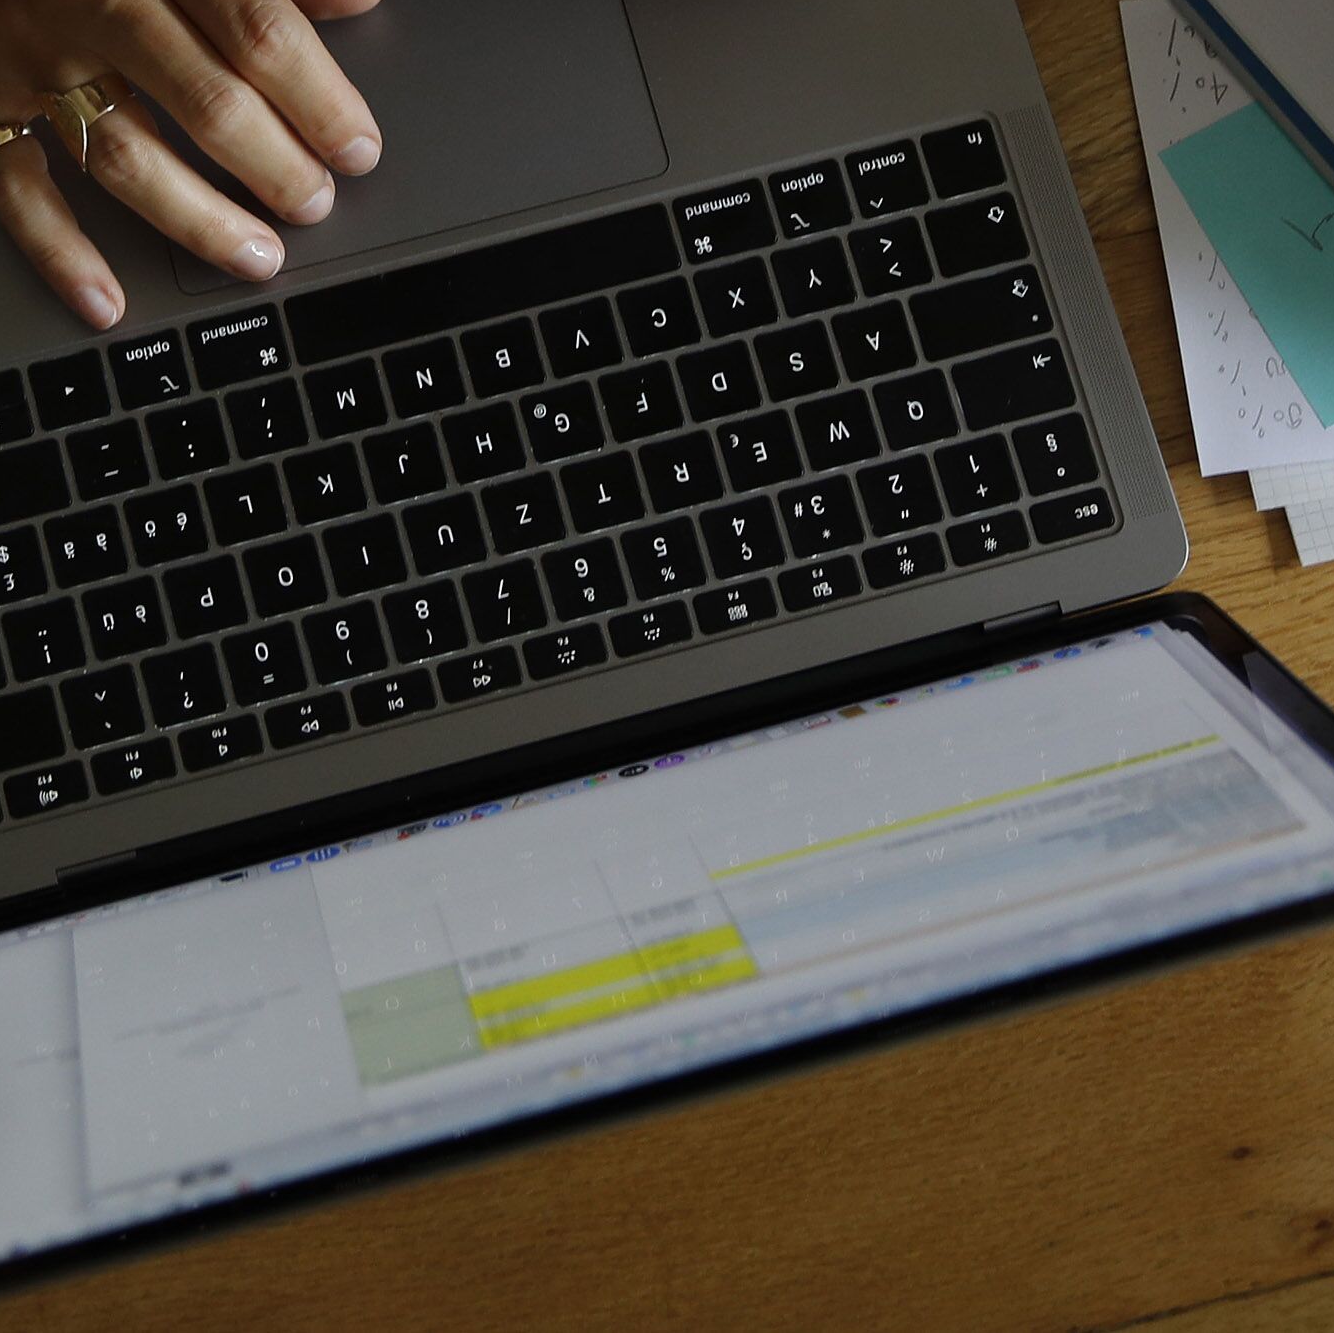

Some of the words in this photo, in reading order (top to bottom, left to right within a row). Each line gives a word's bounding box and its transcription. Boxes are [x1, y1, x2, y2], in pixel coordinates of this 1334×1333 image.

[966, 131, 982, 145] fn
[857, 151, 905, 176] control
[780, 172, 824, 192] option
[684, 191, 750, 220] command
[808, 268, 822, 288] Y
[727, 286, 745, 308] X
[650, 307, 667, 327] C
[200, 315, 268, 344] command
[574, 328, 590, 349] V
[125, 340, 170, 361] option
[865, 330, 879, 351] A
[495, 347, 511, 368] B
[788, 351, 804, 372] S
[415, 367, 433, 389] N
[711, 371, 727, 392] D
[335, 387, 356, 410] M
[635, 391, 648, 413] F
[906, 400, 924, 420] Q
[554, 412, 570, 433] G
[829, 420, 850, 443] W
[474, 431, 493, 454] H
[751, 441, 767, 462] E
[397, 453, 408, 474] J
[673, 461, 689, 482] R
[968, 454, 979, 473] 1
[317, 473, 334, 495] K
[597, 482, 611, 504] T
[887, 473, 903, 494] 2
[238, 494, 253, 513] L
[515, 502, 532, 525] Z
[810, 494, 825, 515] 3
[1074, 503, 1098, 519] esc
[144, 519, 156, 538] ö
[175, 511, 187, 531] é
[731, 517, 745, 536] 4
[980, 522, 990, 533] F1
[95, 532, 107, 551] à
[437, 524, 454, 545] U
[63, 541, 75, 559] ä
[361, 545, 369, 565] I
[652, 536, 667, 557] 5
[896, 545, 907, 556] F2
[277, 566, 294, 586] O
[574, 557, 588, 578] 6
[811, 567, 823, 578] F3
[199, 586, 214, 607] P
[497, 578, 509, 599] 7
[727, 590, 739, 601] F4
[134, 604, 146, 623] è
[414, 599, 429, 619] 8
[642, 612, 654, 623] F5
[102, 612, 114, 631] ü
[335, 619, 350, 640] 9
[254, 641, 269, 662] 0
[556, 636, 569, 646] F6
[472, 658, 483, 669] F7
[385, 681, 398, 692] F8
[299, 704, 311, 715] F9
[211, 726, 227, 738] F10
[124, 750, 139, 761] F11
[37, 773, 52, 786] F12
